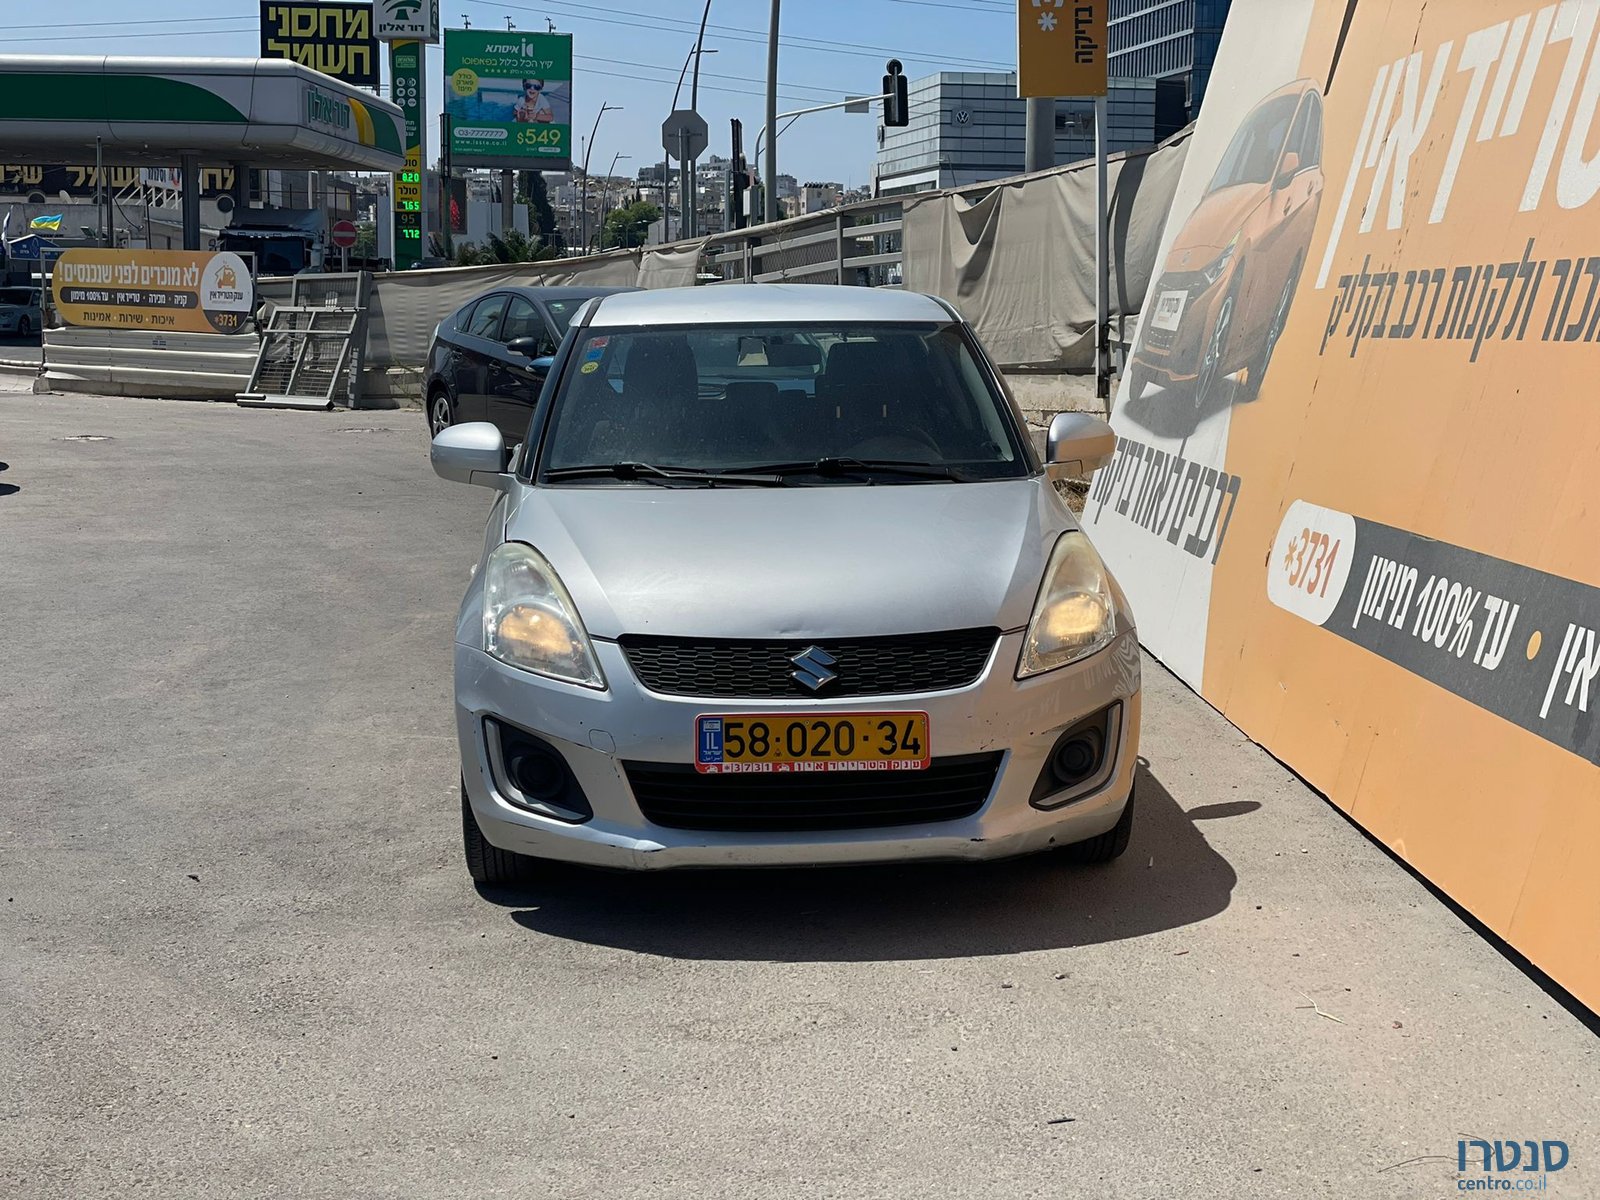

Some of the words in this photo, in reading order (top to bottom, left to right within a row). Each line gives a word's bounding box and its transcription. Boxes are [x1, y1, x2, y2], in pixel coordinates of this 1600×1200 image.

[268, 6, 369, 39] מחסני
[379, 22, 405, 33] אלון
[407, 23, 425, 32] דור
[485, 44, 520, 54] איסתא
[540, 60, 553, 70] קיץ
[517, 128, 561, 145] $549
[1314, 39, 1454, 289] אין
[401, 214, 415, 224] 95
[59, 261, 112, 284] שנכנסים!
[115, 260, 138, 285] לפני
[141, 265, 180, 286] מוכרים
[183, 261, 200, 287] לא
[1389, 268, 1447, 340] רכב
[83, 311, 111, 322] אמינות
[119, 313, 143, 324] שירות
[151, 314, 175, 325] איכות
[1352, 554, 1419, 630] מימון
[1412, 574, 1482, 658] 100%
[1473, 594, 1520, 671] עד
[706, 732, 719, 750] IL
[794, 761, 824, 772] אין
[828, 760, 887, 771] הטרייד
[892, 760, 920, 770] ענק
